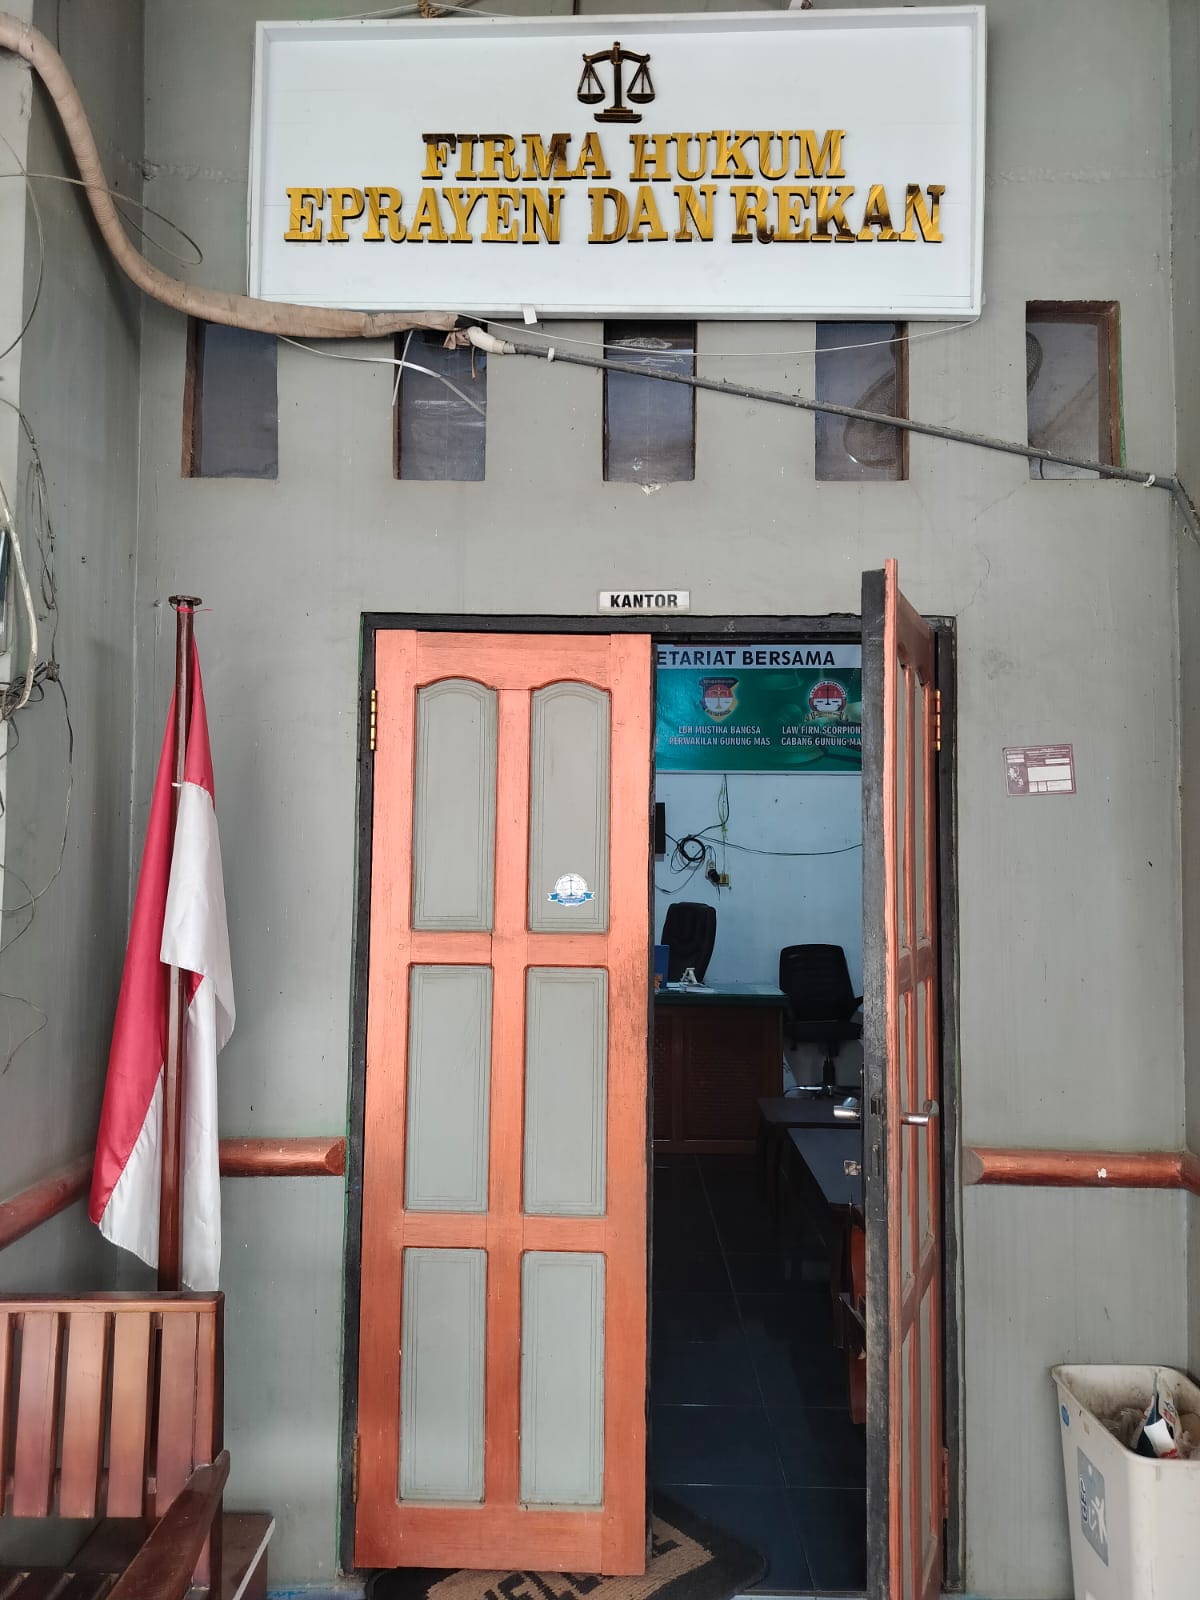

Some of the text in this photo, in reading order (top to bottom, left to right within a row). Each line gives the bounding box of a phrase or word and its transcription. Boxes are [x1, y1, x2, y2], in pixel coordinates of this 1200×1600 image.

[421, 129, 846, 182] FIRMA HUKUM
[285, 183, 946, 245] EPRAYEN DAN REKAN
[610, 594, 678, 608] KANTOR
[742, 650, 836, 666] BERSAMA
[696, 725, 729, 735] MUSTIKA
[730, 725, 761, 735] BANGSA
[782, 725, 799, 735] LAW
[801, 725, 819, 735] FIRM
[669, 736, 718, 746] PERWAKILAN
[719, 736, 751, 746] GUNUNG
[753, 736, 771, 746] MAS
[781, 736, 813, 746] CABANG
[814, 736, 847, 746] GUNUNG
